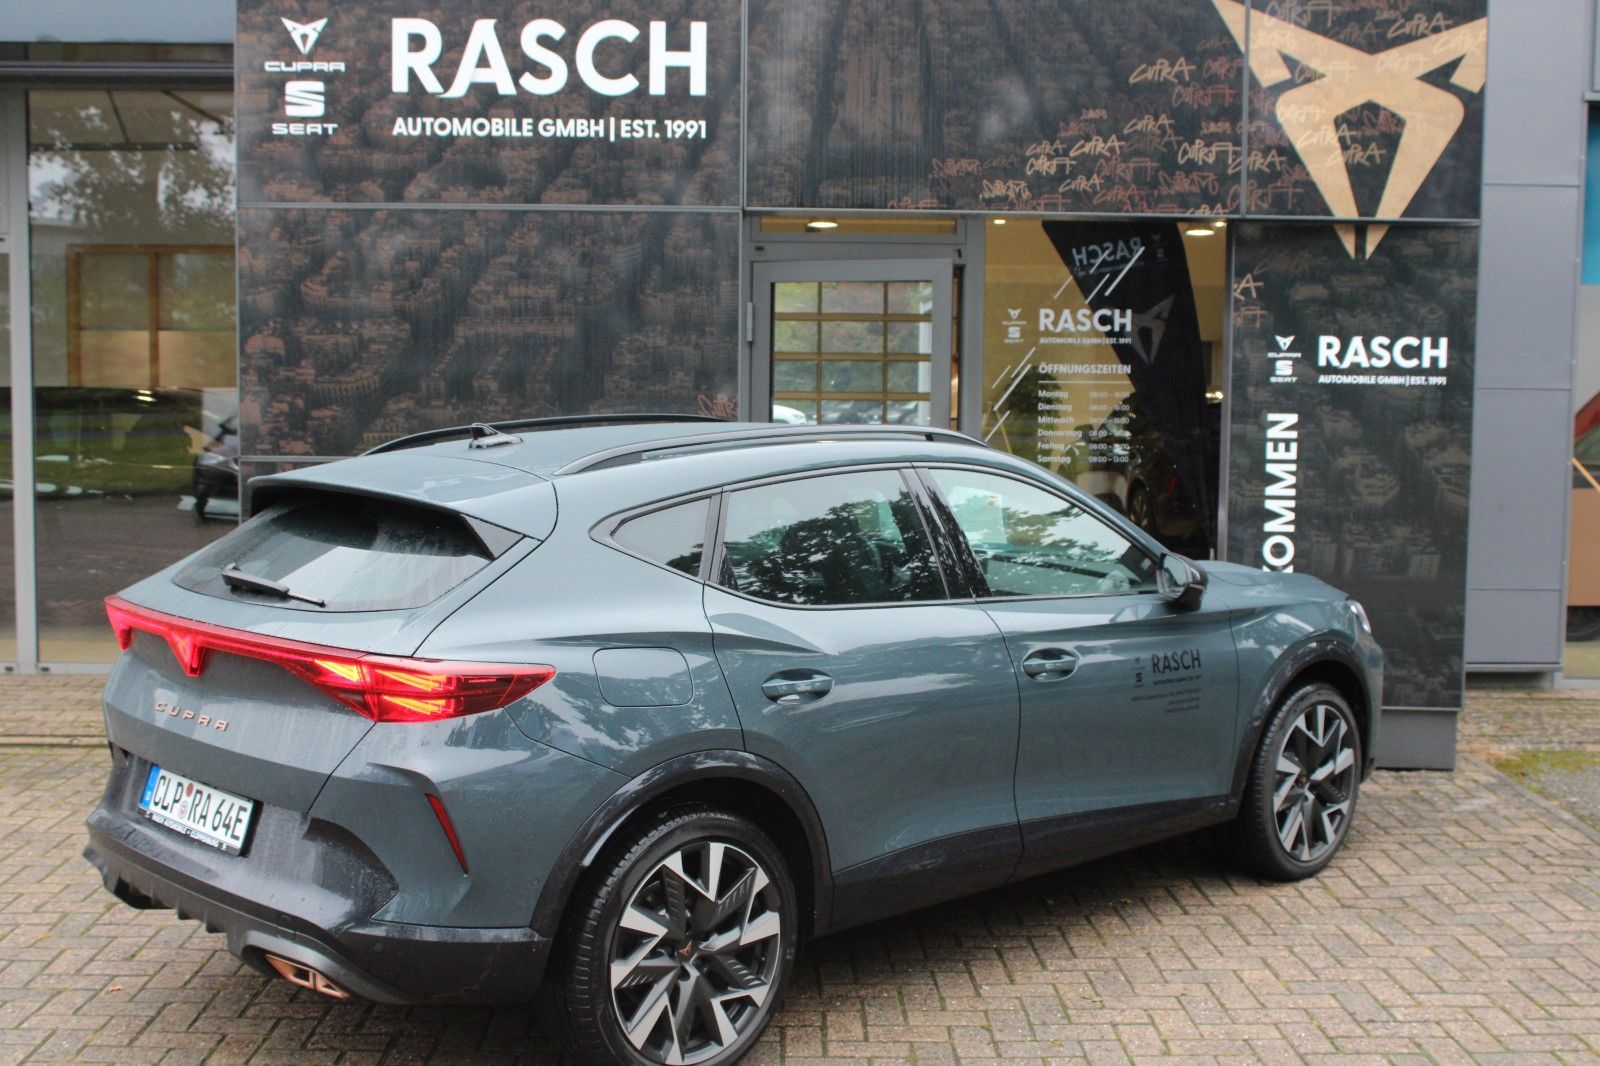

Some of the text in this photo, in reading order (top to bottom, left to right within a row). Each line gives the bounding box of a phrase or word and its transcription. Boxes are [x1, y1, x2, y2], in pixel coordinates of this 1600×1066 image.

[391, 17, 707, 99] RASCH
[264, 61, 346, 73] CUPRA
[271, 123, 339, 136] SEAT
[392, 116, 533, 138] AUTOMOBILE
[538, 117, 604, 138] GMBH
[620, 119, 659, 139] EST.
[664, 119, 707, 139] 1991
[1038, 308, 1132, 333] RASCH
[1317, 335, 1449, 369] RASCH
[1038, 362, 1132, 375] ÖFFNUNGSZEITEN
[1318, 375, 1376, 384] AUTOMOBILE
[1038, 390, 1069, 399] Montag
[1038, 403, 1072, 412] Dienstag
[1037, 429, 1083, 438] Donnerstag
[1037, 442, 1065, 451] Freitag
[1037, 455, 1072, 464] Samstag
[1262, 413, 1299, 573] OMMEN
[1151, 649, 1201, 674] RASCH
[154, 701, 229, 732] CUPRA
[153, 775, 184, 814] CLP
[187, 788, 212, 827] RA
[211, 798, 248, 842] 64E
